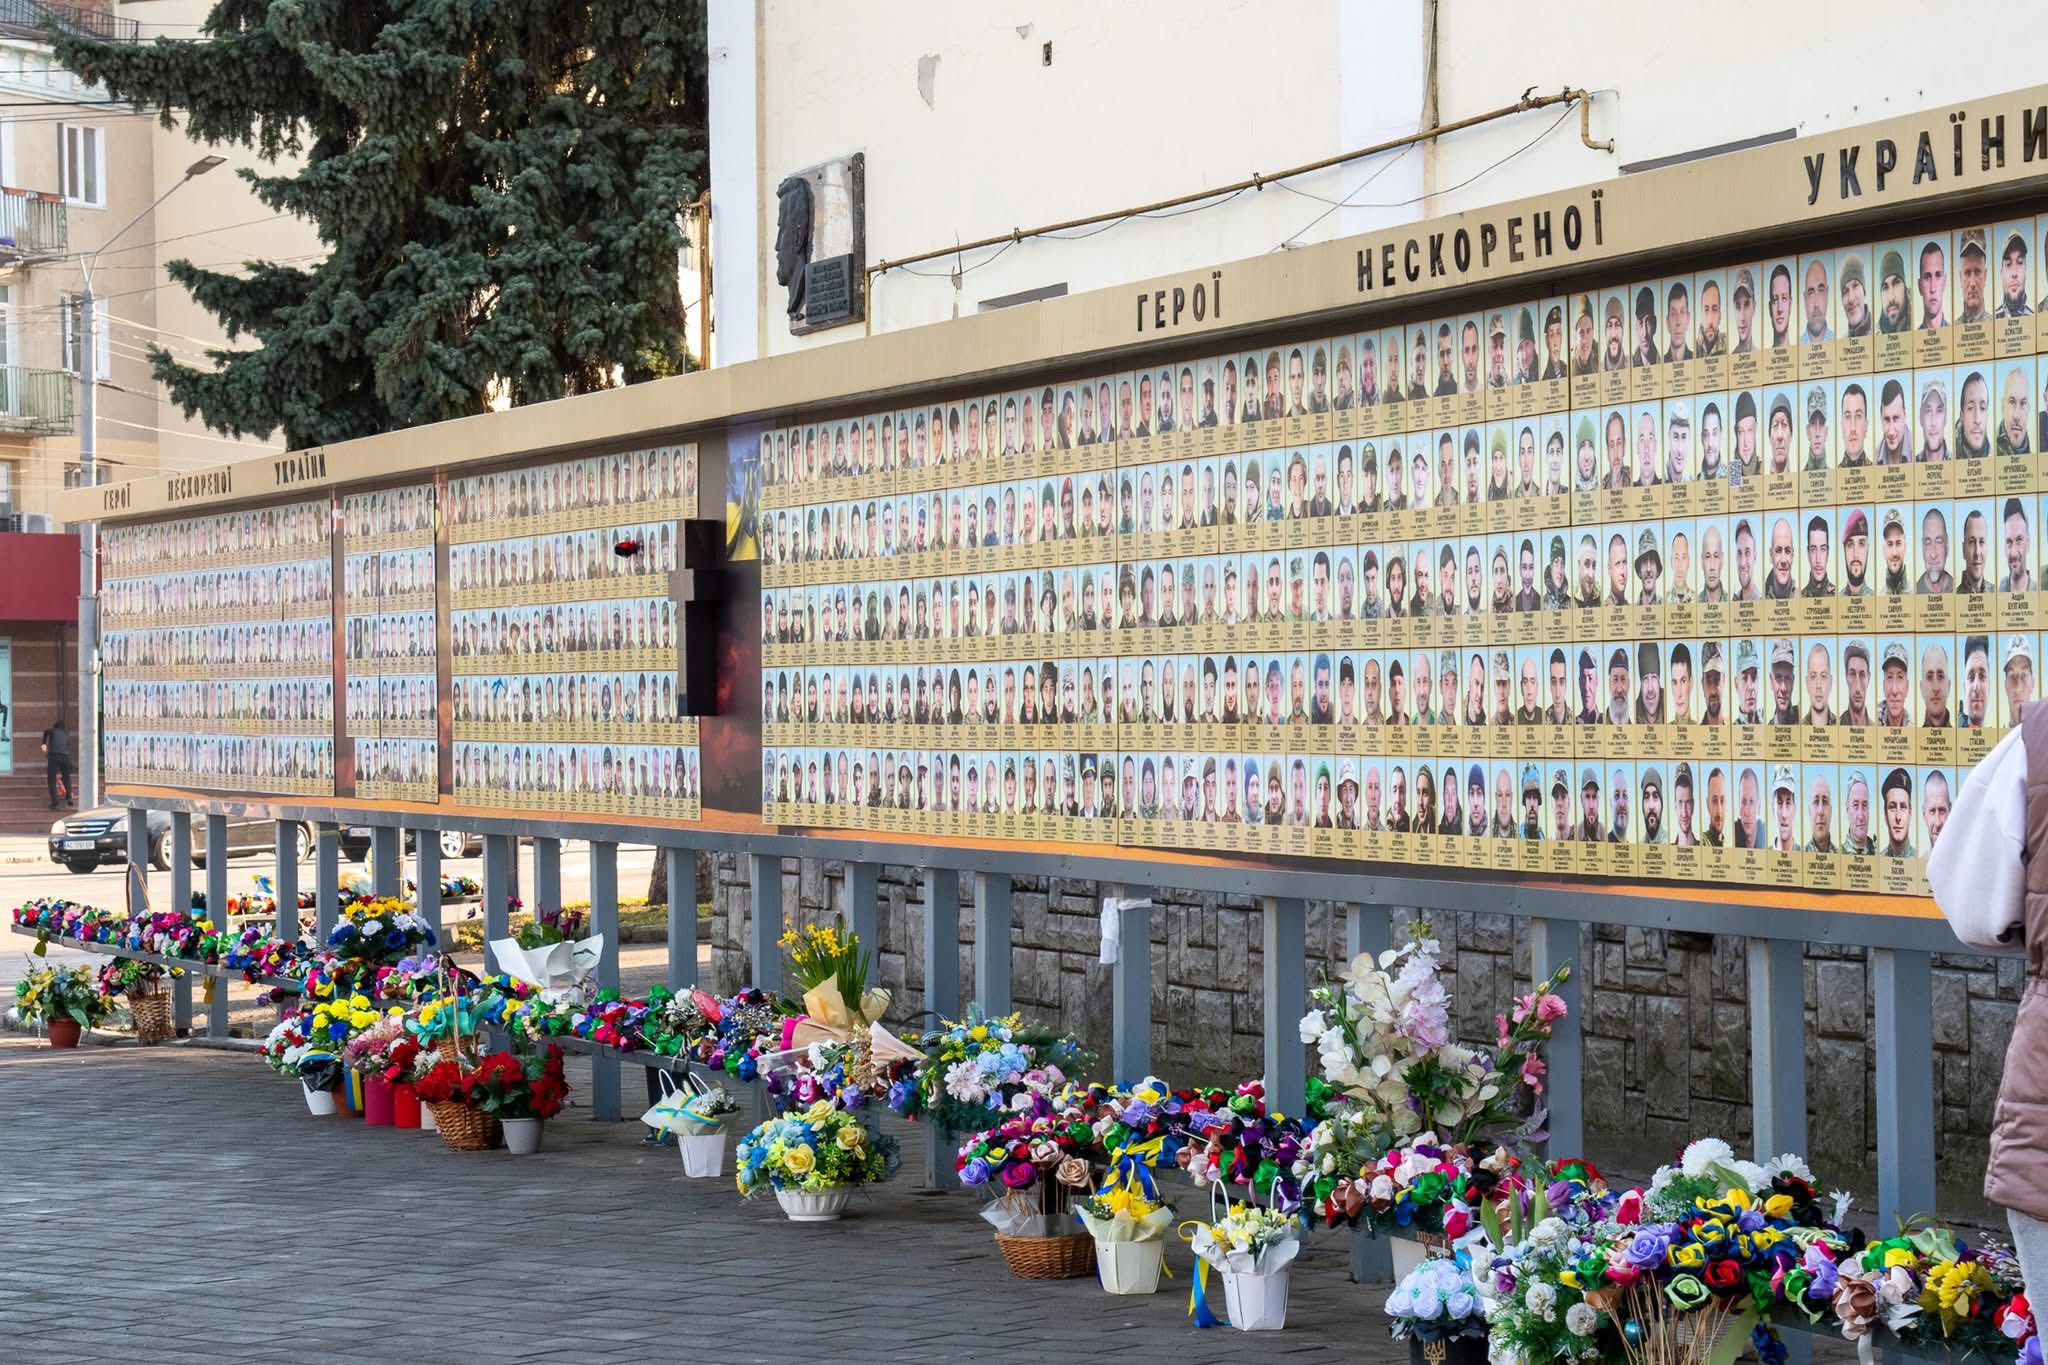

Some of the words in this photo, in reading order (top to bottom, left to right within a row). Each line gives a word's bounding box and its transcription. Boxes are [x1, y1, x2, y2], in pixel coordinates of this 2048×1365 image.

[1136, 271, 1221, 332] ГЕРОЇ
[1357, 189, 1604, 292] НЕСКОРЕНОЇ
[1803, 105, 2048, 206] УКРАЇНИ
[103, 483, 131, 511] ГЕРОЇ
[168, 466, 232, 502] НЕСКОРЕНОЇ
[274, 451, 326, 486] УКРАЇНИ
